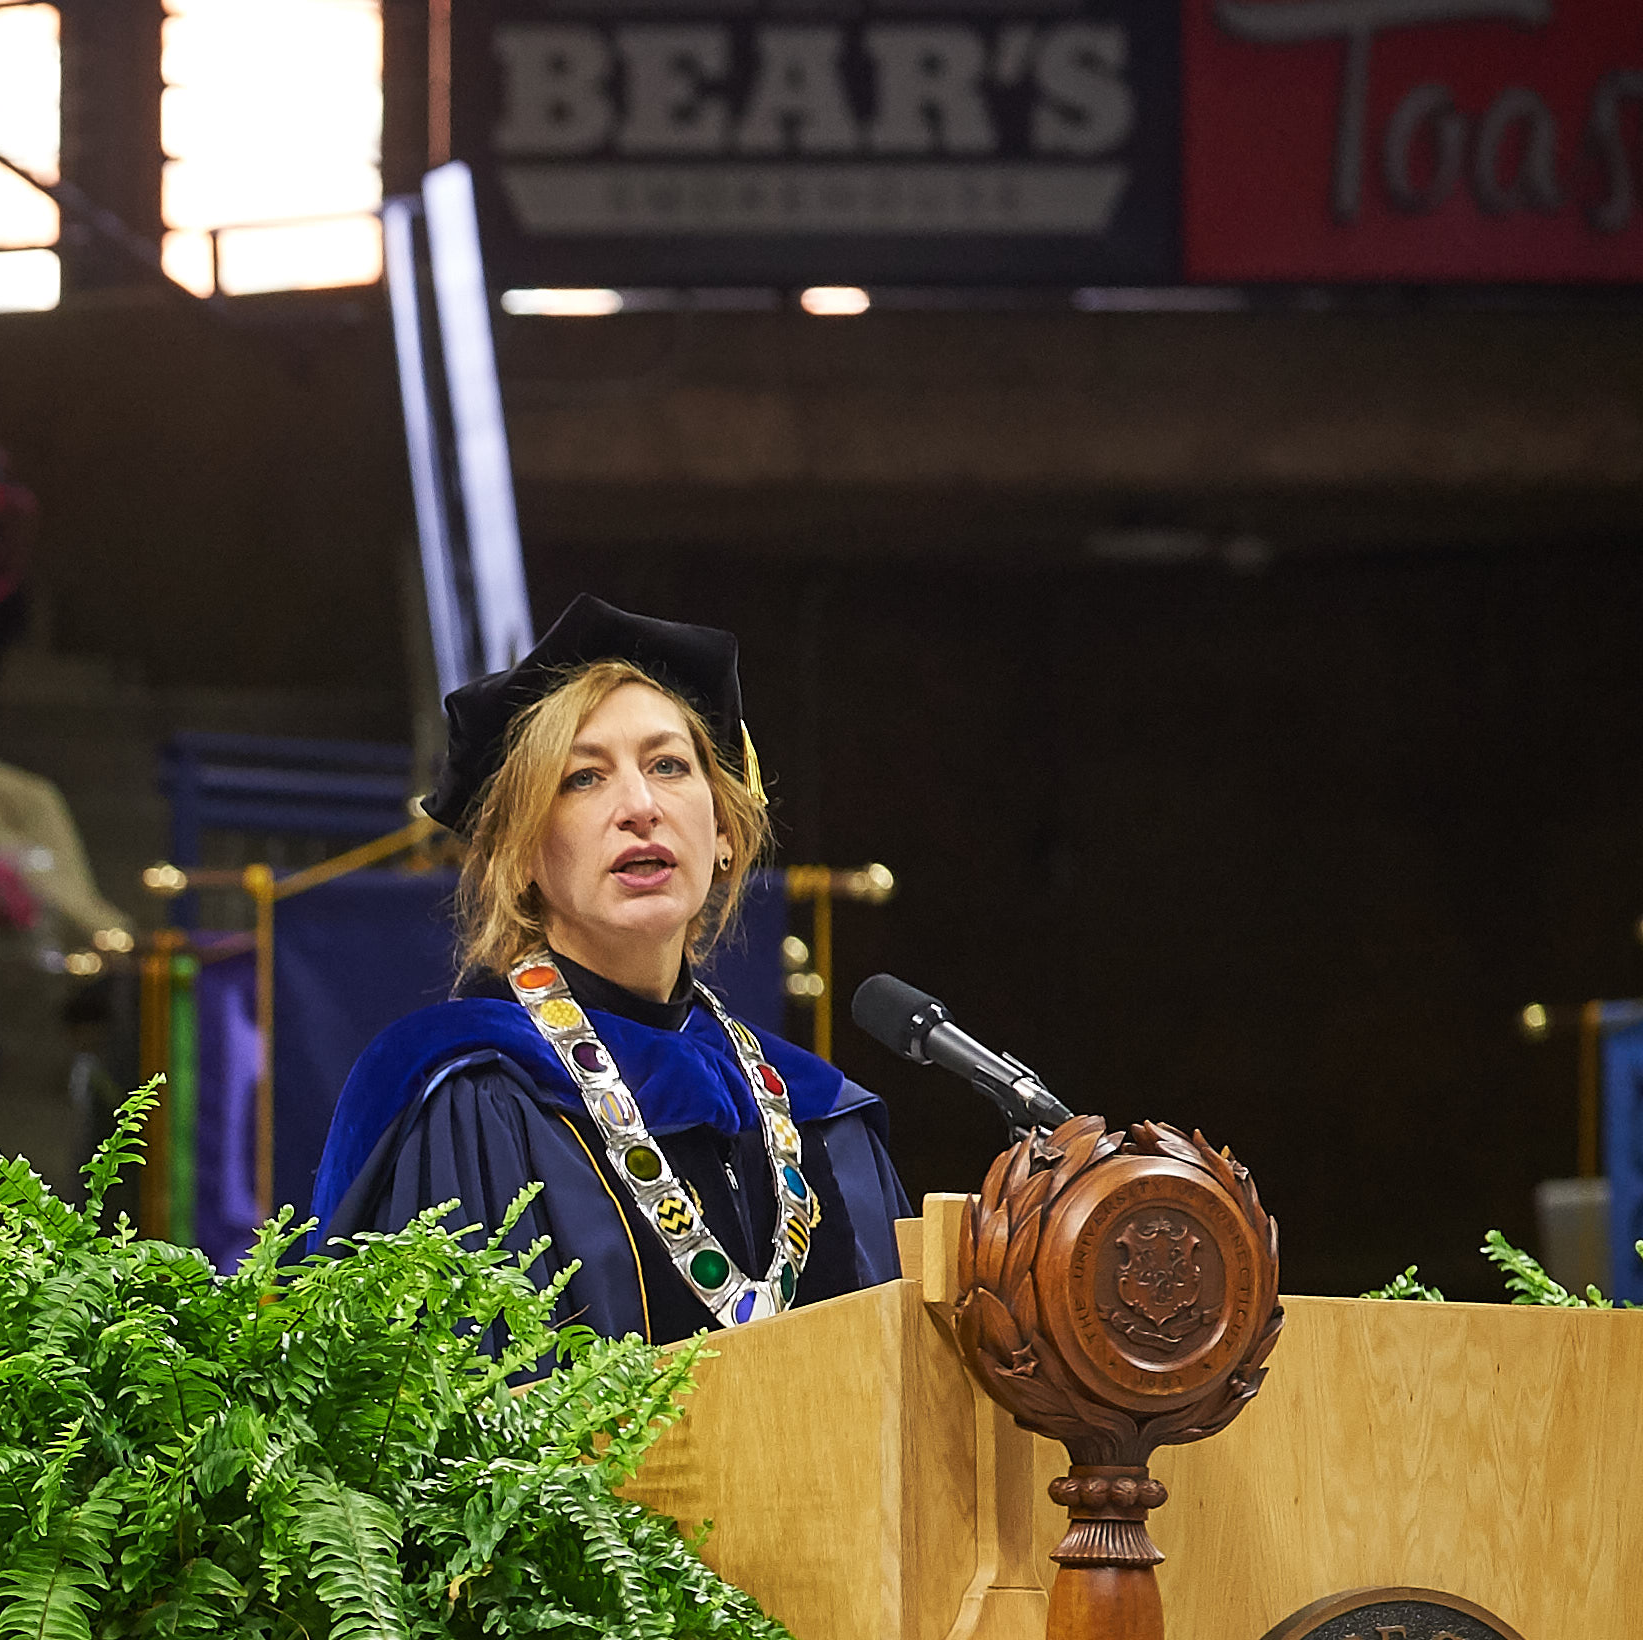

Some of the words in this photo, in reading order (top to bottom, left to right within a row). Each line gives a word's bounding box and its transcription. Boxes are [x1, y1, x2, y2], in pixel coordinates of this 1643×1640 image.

[494, 23, 1134, 155] BEAR'S
[1074, 1181, 1164, 1280] UNIVERSITY
[1075, 1297, 1097, 1345] THE
